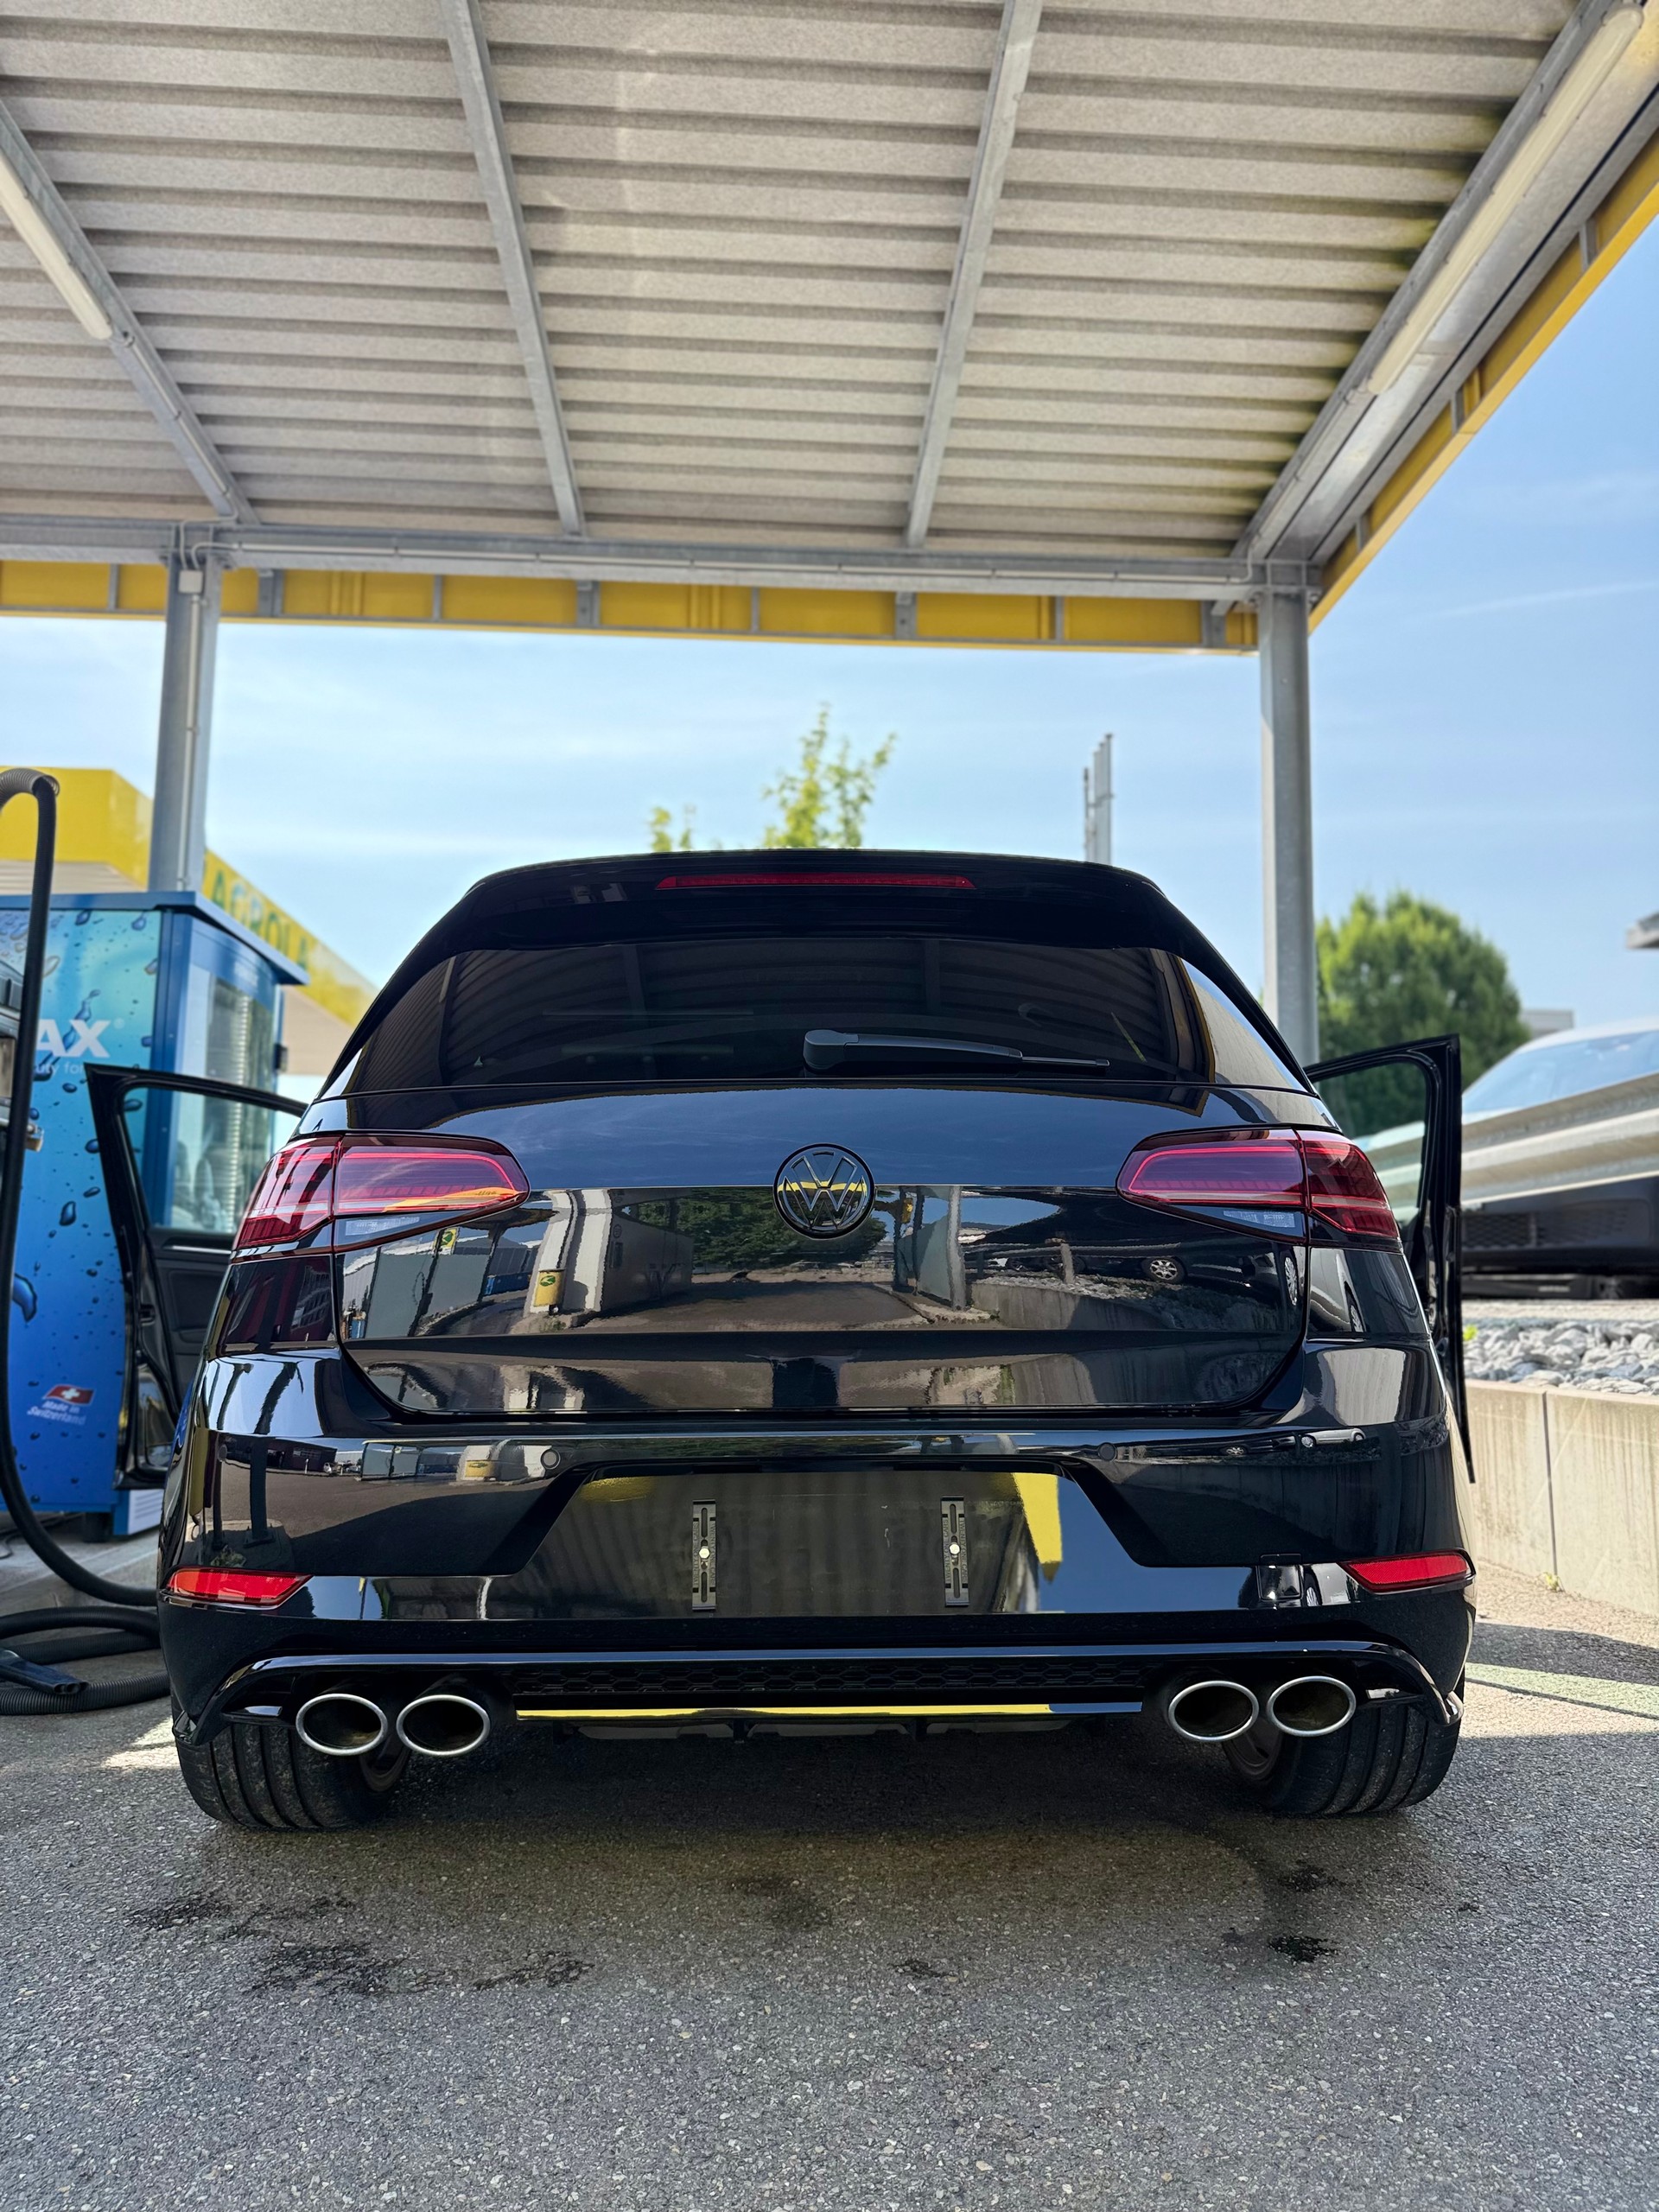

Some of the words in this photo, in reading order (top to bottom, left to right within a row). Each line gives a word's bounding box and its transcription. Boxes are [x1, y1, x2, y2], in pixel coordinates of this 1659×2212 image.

[777, 1147, 871, 1236] VW
[27, 1406, 86, 1426] Switzerland
[41, 1400, 69, 1412] Made
[69, 1405, 80, 1414] in
